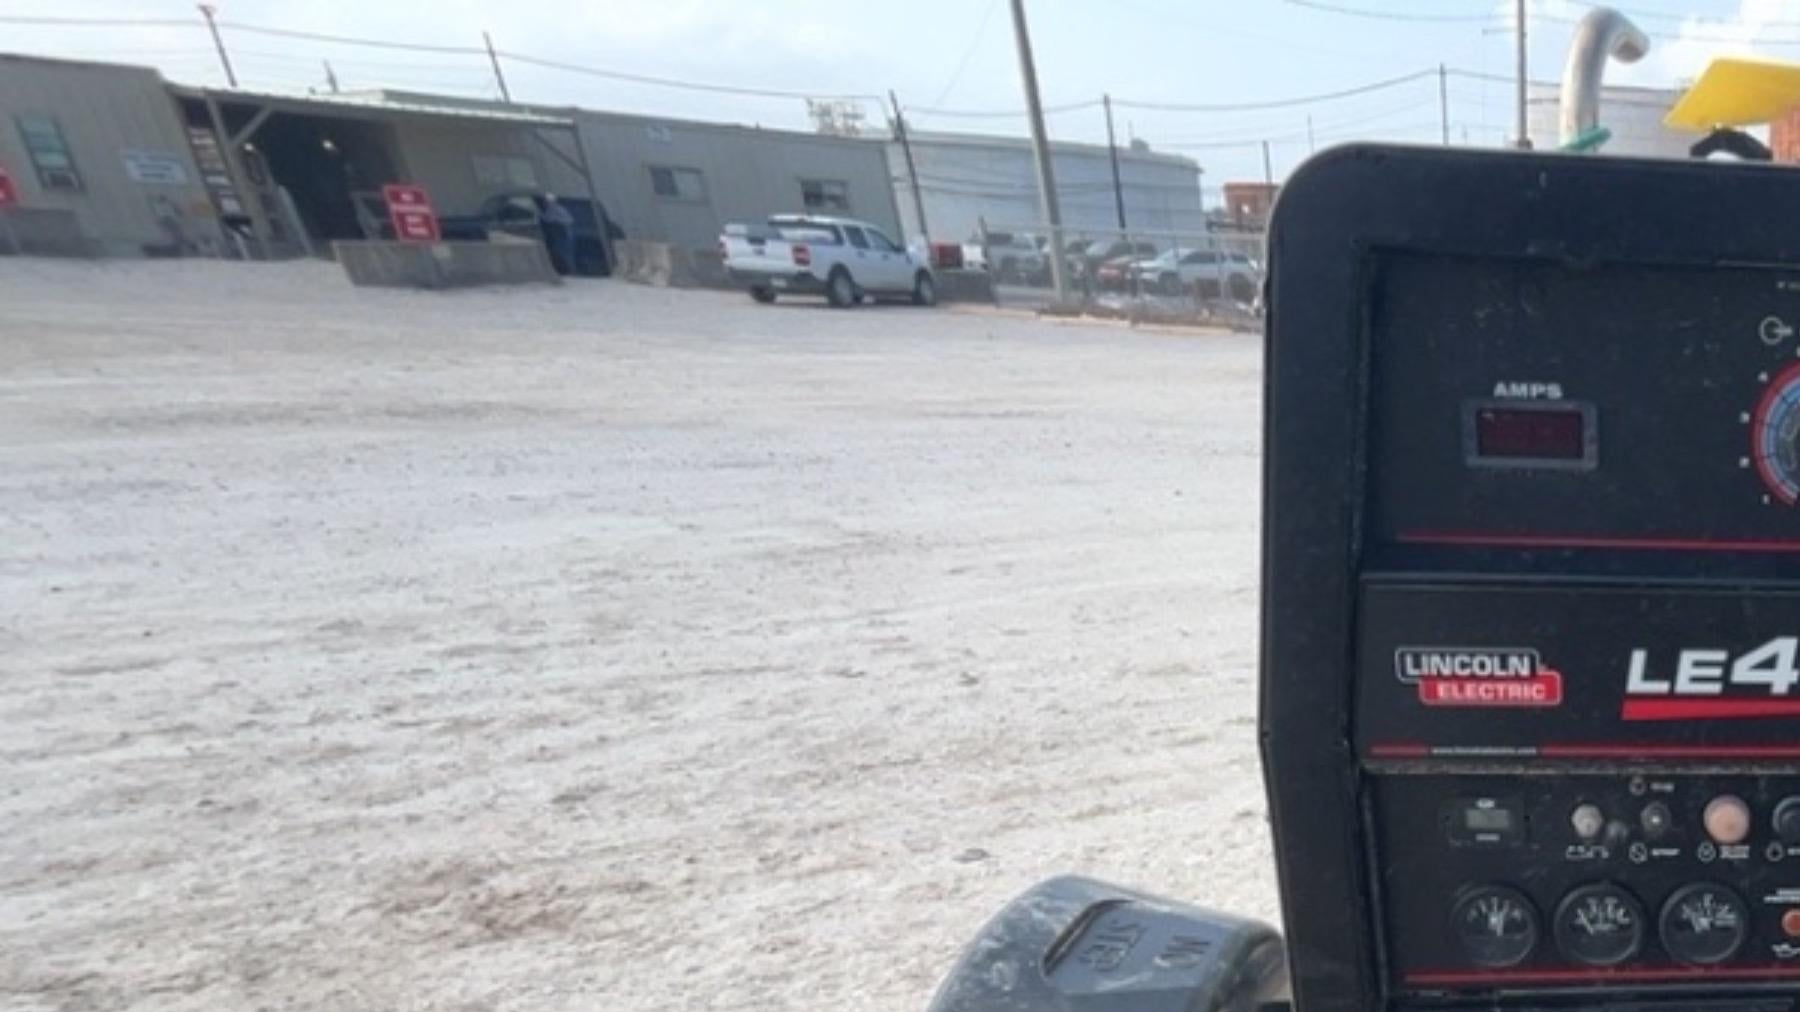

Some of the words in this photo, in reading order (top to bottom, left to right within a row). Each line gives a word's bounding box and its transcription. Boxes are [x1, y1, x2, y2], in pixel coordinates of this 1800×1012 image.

[1494, 382, 1563, 399] AMPS
[1405, 654, 1531, 677] LINCOLN
[1437, 682, 1547, 700] ELECTRIC
